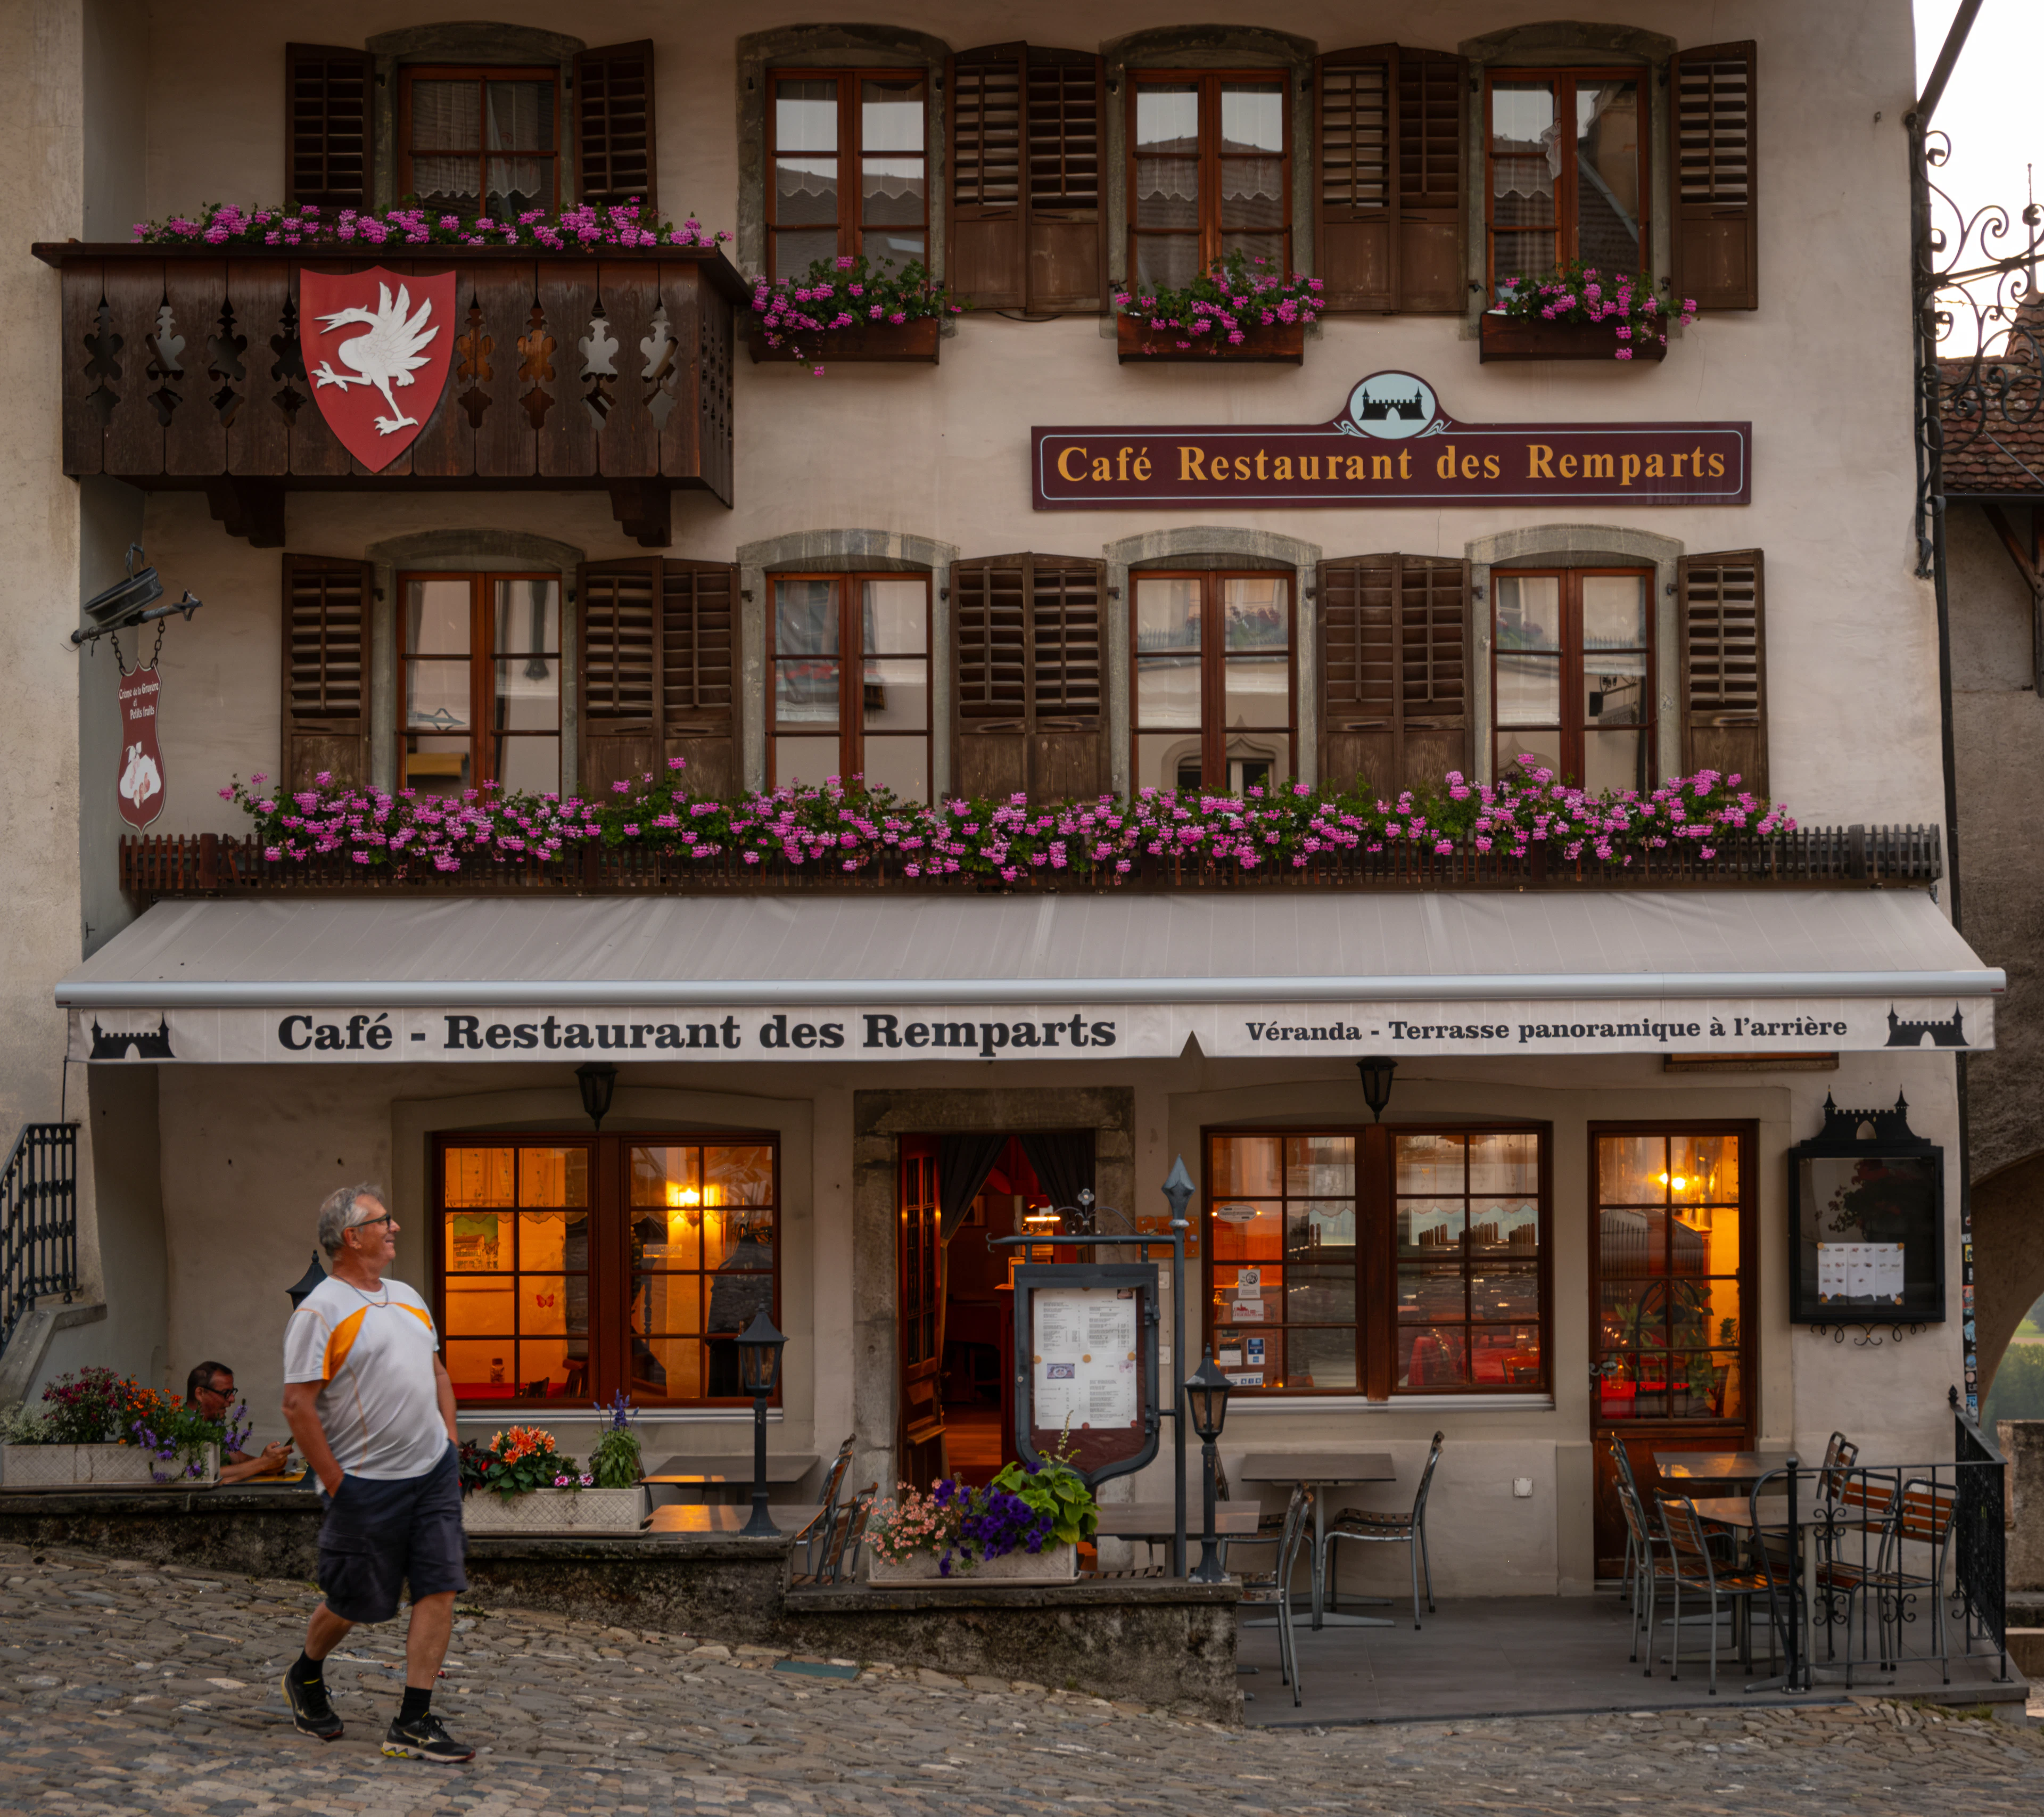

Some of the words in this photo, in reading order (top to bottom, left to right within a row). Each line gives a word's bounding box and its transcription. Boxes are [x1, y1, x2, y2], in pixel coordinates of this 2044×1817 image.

[1057, 446, 1152, 482] Café
[1177, 446, 1412, 481] Restaurant
[1437, 445, 1501, 480] des
[1526, 445, 1725, 486] Remparts
[119, 688, 132, 700] Crème
[133, 687, 137, 696] de
[130, 708, 142, 720] Petits
[143, 705, 155, 717] fruits
[278, 1013, 393, 1050] Café
[443, 1015, 741, 1049] Restaurant
[759, 1014, 845, 1049] des
[862, 1014, 1117, 1057] Remparts
[1246, 1021, 1363, 1041] Véranda
[1388, 1021, 1510, 1040] Terrasse
[1518, 1018, 1701, 1043] panoramique
[1710, 1016, 1726, 1037] à
